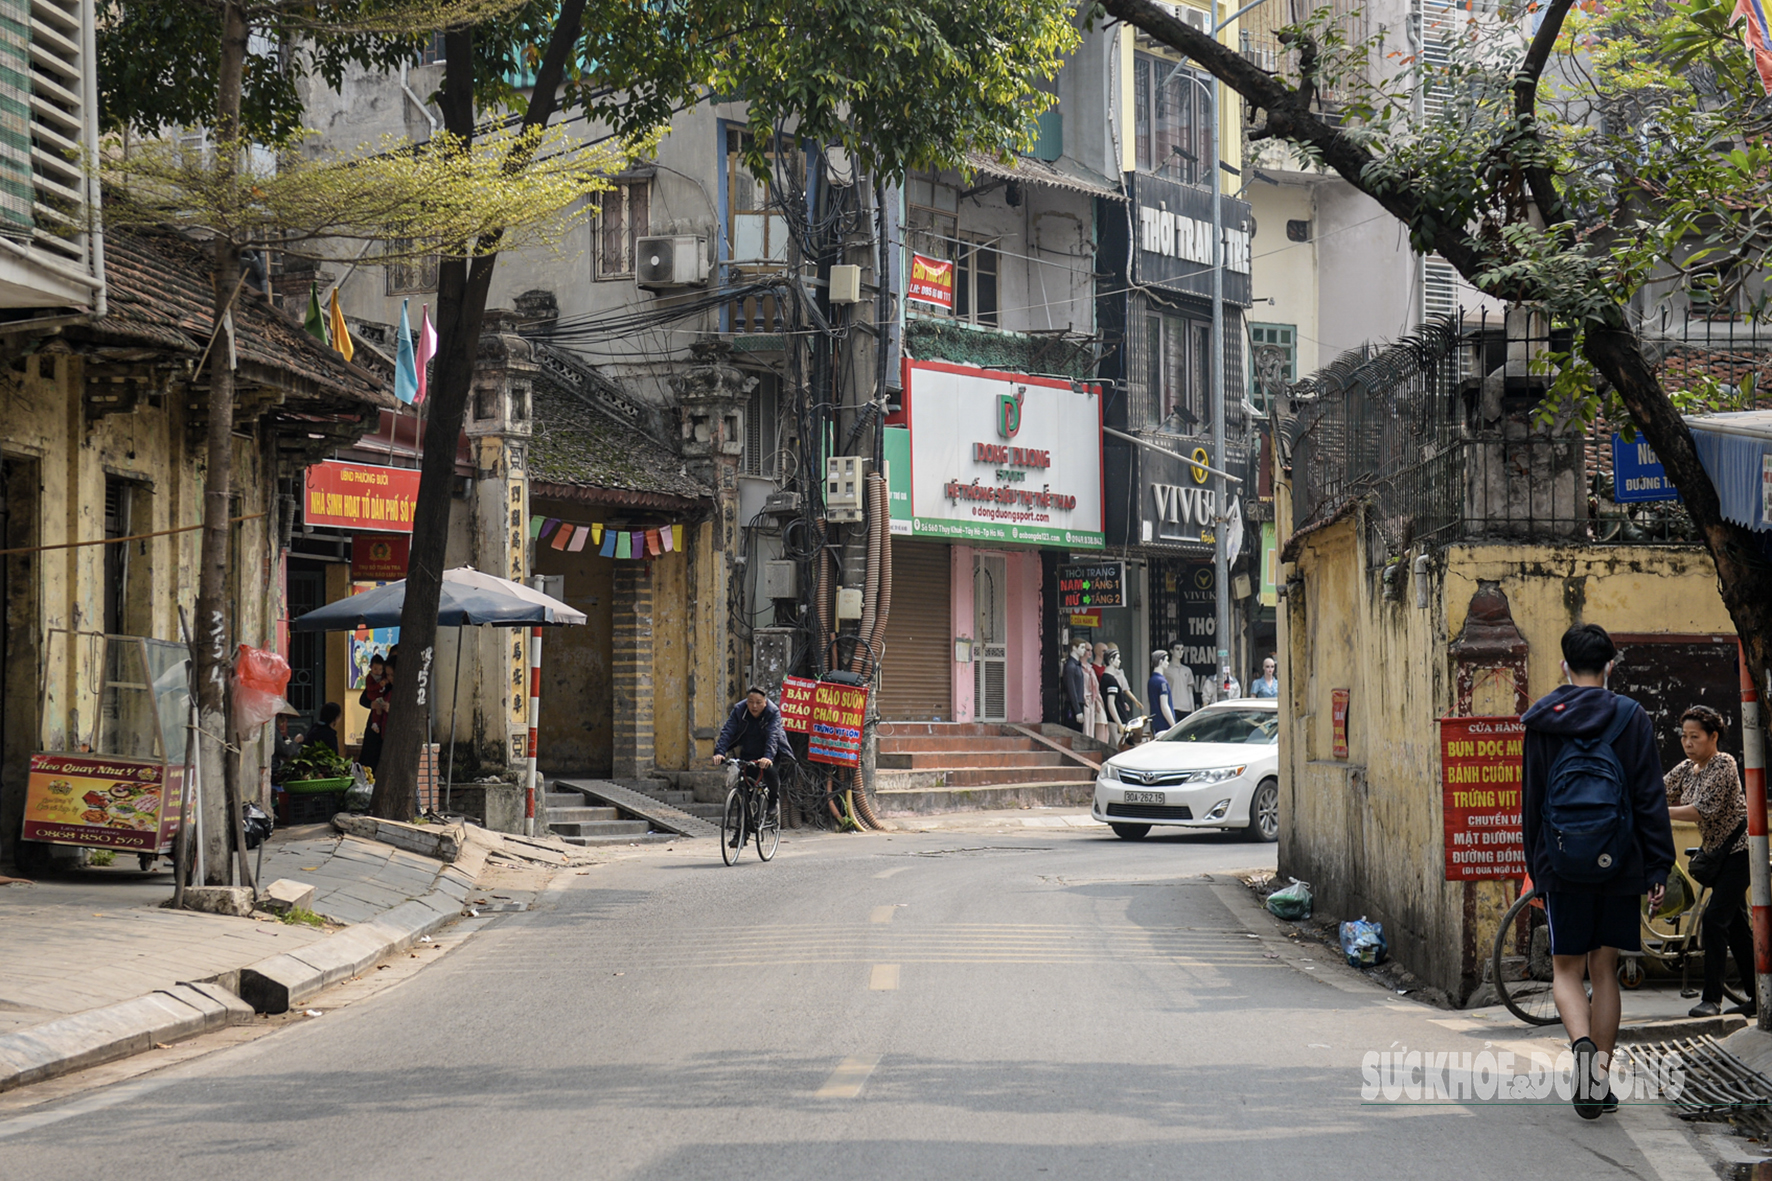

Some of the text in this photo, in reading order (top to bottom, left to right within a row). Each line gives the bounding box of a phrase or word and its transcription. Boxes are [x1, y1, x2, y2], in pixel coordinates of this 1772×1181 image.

[1140, 200, 1175, 257] THỜI
[1225, 220, 1250, 275] TRẺ
[1637, 443, 1661, 465] NG
[340, 470, 354, 482] UBND
[996, 469, 1026, 482] SPORT
[960, 477, 995, 502] THỐNG
[995, 484, 1017, 504] SIÊU
[1051, 493, 1076, 510] THAO
[311, 488, 326, 515] NHÀ
[326, 493, 343, 516] SINH
[343, 494, 360, 522] HOẠT
[362, 489, 371, 519] TỔ
[371, 494, 384, 520] DÂN
[385, 494, 399, 521] PHỐ
[400, 494, 410, 522] SỐ
[928, 524, 938, 532] 560
[1065, 566, 1116, 578] THỜI TRANG
[1060, 579, 1083, 591] NAM
[1115, 579, 1119, 589] 1
[1065, 591, 1081, 606] NỮ
[1114, 594, 1121, 604] 2
[1188, 612, 1217, 636] THỜ
[786, 688, 811, 701] BÁN
[815, 686, 840, 706] CHÁO
[781, 702, 811, 716] CHÁO
[781, 717, 807, 730] TRAI
[813, 707, 862, 727] CHÁO TRAI
[1468, 721, 1527, 733] CỬA HÀNG
[1448, 738, 1475, 757] BÚN
[1477, 740, 1504, 760] DỌC
[36, 762, 60, 771] Heo
[61, 763, 96, 774] Quay
[1448, 763, 1479, 783] BÁNH
[1482, 760, 1514, 783] CUỐN
[1126, 792, 1164, 803] 30A-262.15
[1453, 788, 1495, 807] TRỨNG
[1497, 790, 1517, 810] VỊT
[1468, 811, 1509, 825] CHUYỂN
[35, 829, 144, 846] 0868 850 579
[1454, 829, 1523, 847] MẶT ĐƯỜNG
[1452, 849, 1494, 864] ĐƯỜNG
[1476, 866, 1492, 875] QUA
